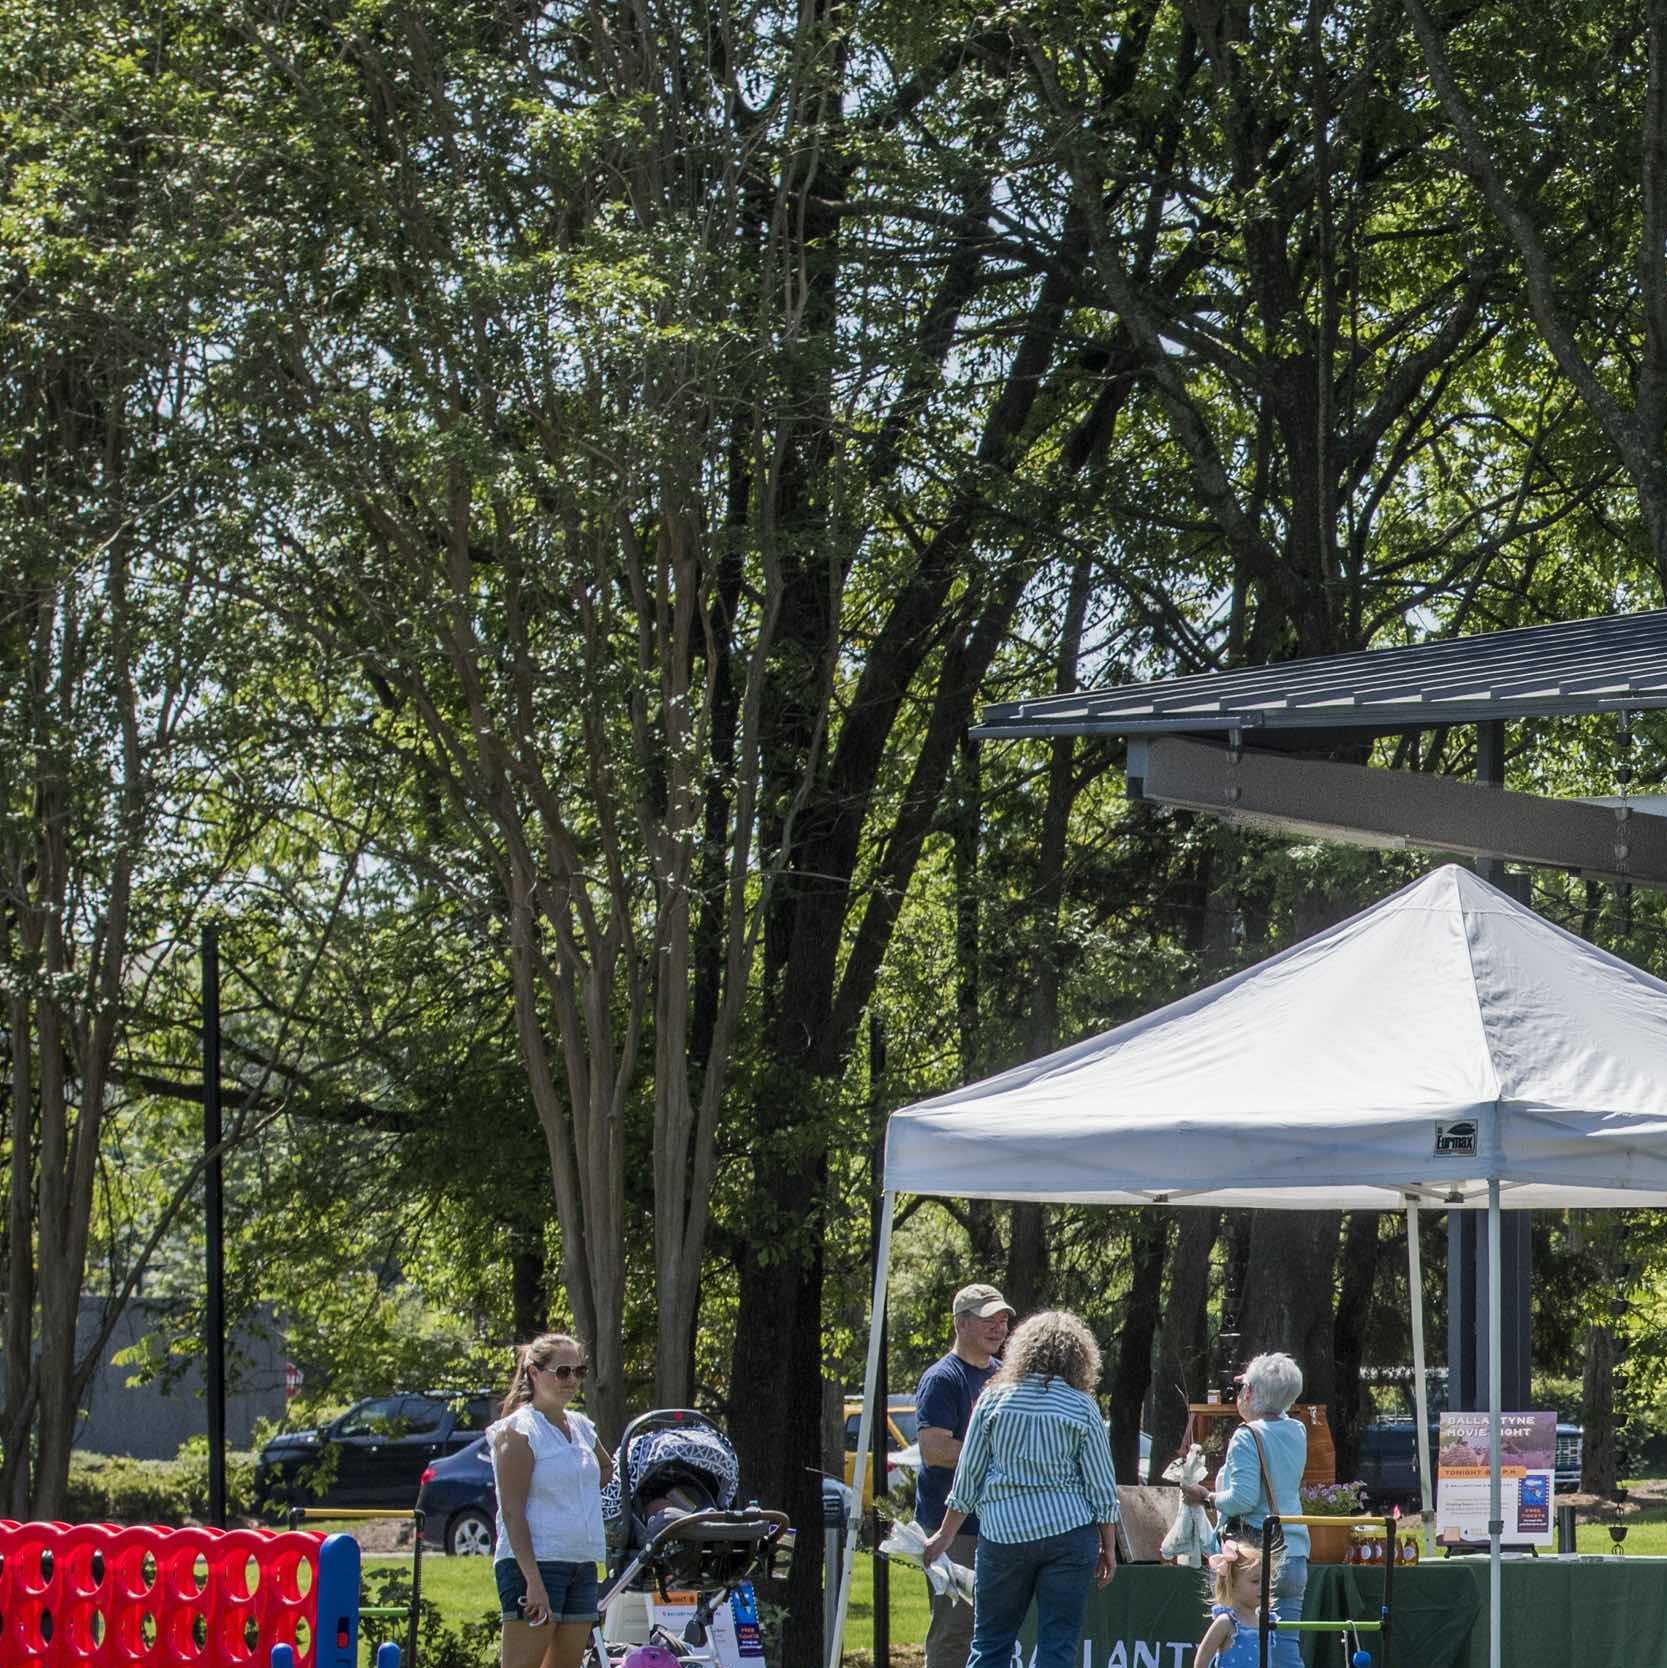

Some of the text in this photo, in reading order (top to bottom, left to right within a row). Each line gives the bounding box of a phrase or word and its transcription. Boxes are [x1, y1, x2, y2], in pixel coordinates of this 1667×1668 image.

[1437, 1135, 1473, 1149] Eurmax
[1447, 1416, 1536, 1425] BALLATYNE
[1447, 1427, 1488, 1437] MOVIE
[1445, 1470, 1481, 1479] TONIGHT
